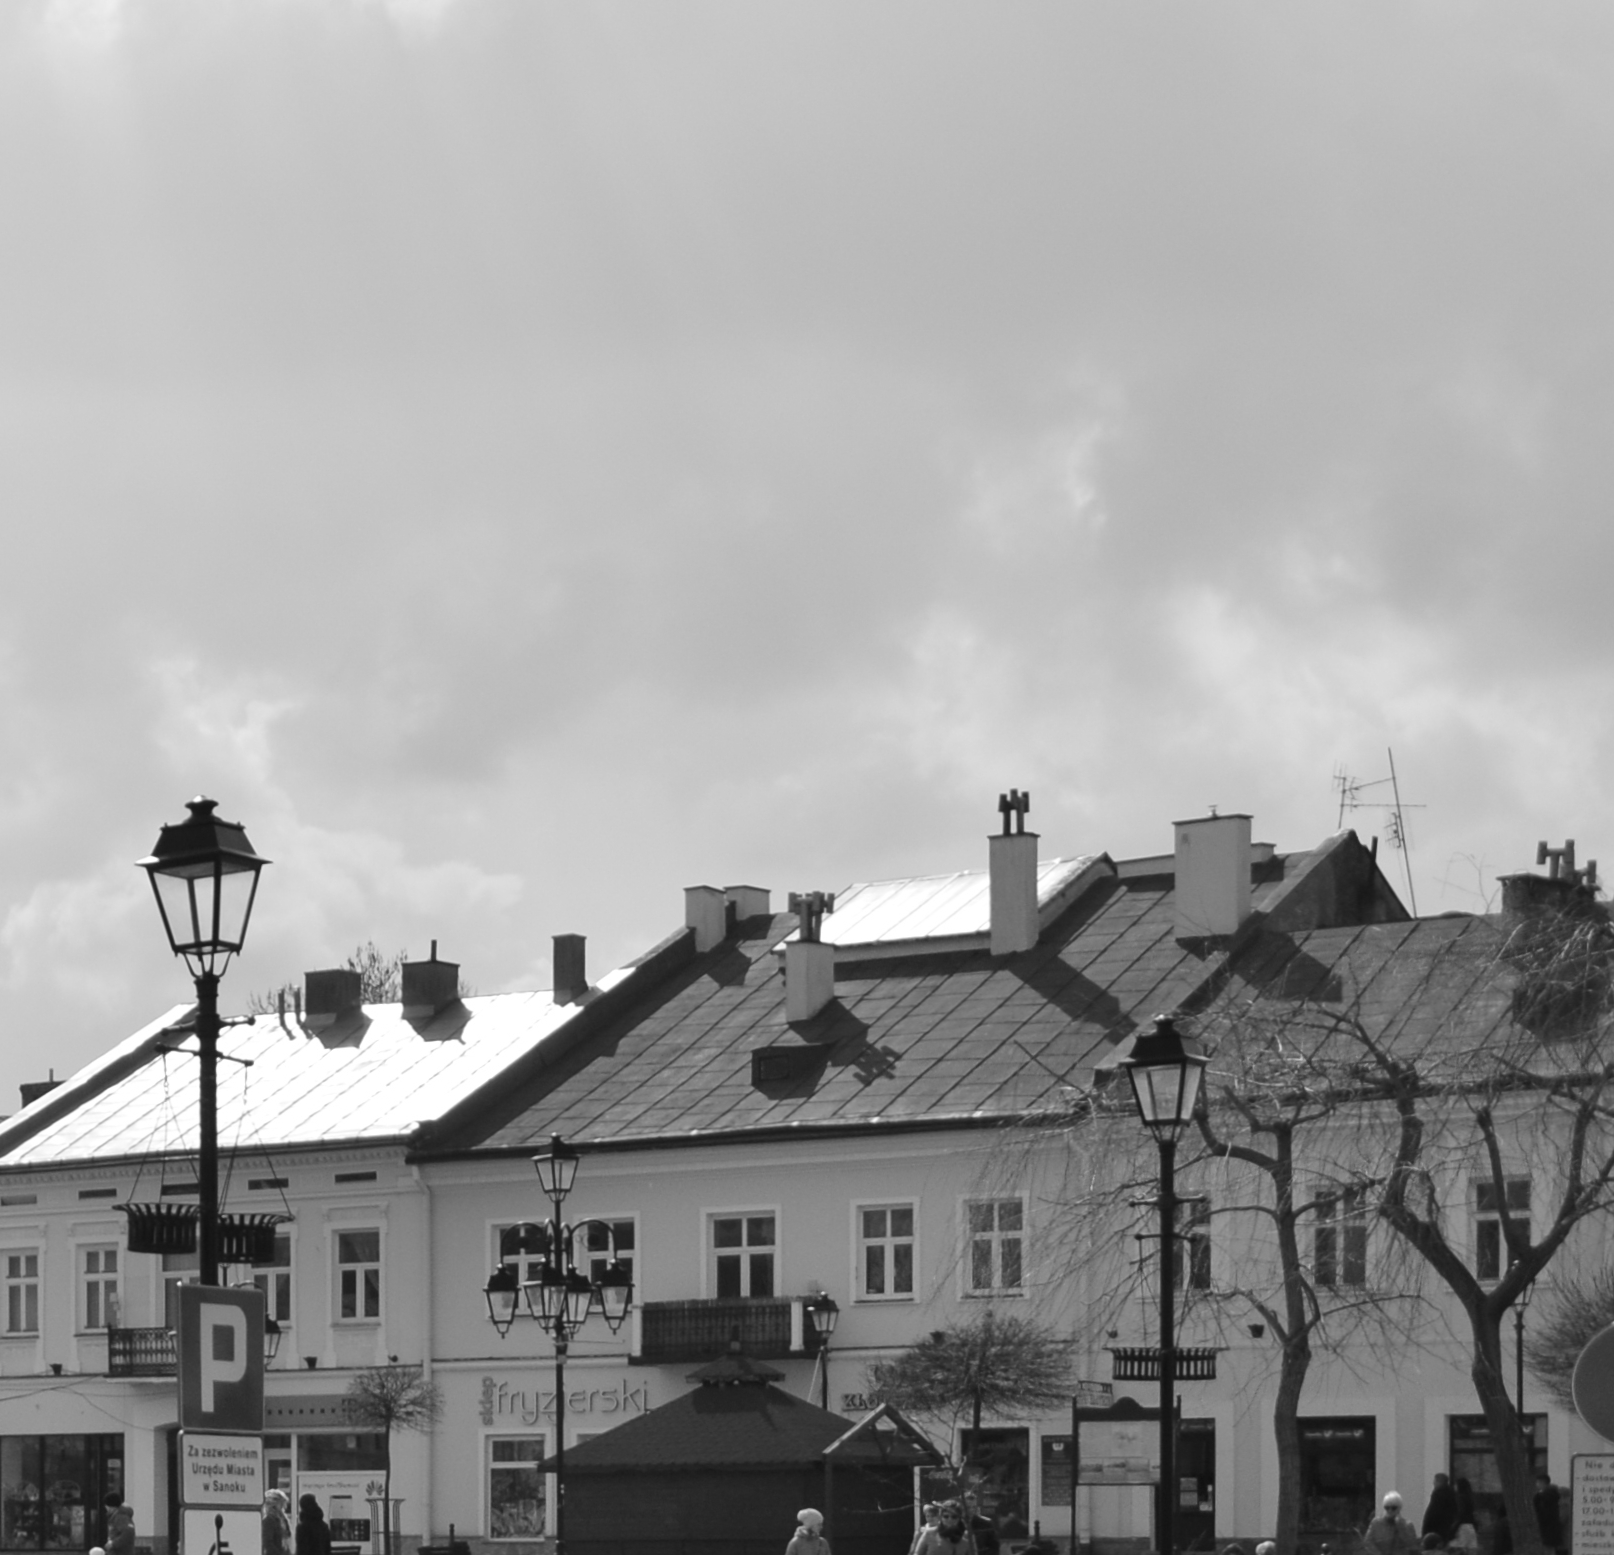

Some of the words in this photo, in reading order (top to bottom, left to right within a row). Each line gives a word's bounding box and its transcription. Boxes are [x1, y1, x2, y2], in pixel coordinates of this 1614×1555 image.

[200, 1302, 247, 1413] P
[479, 1376, 496, 1426] sklep
[188, 1445, 199, 1457] Za
[202, 1446, 258, 1459] zezwoleniem
[192, 1462, 224, 1478] Urzędu
[226, 1463, 255, 1476] Miasta
[203, 1483, 210, 1491] w
[212, 1480, 246, 1493] Sanoku
